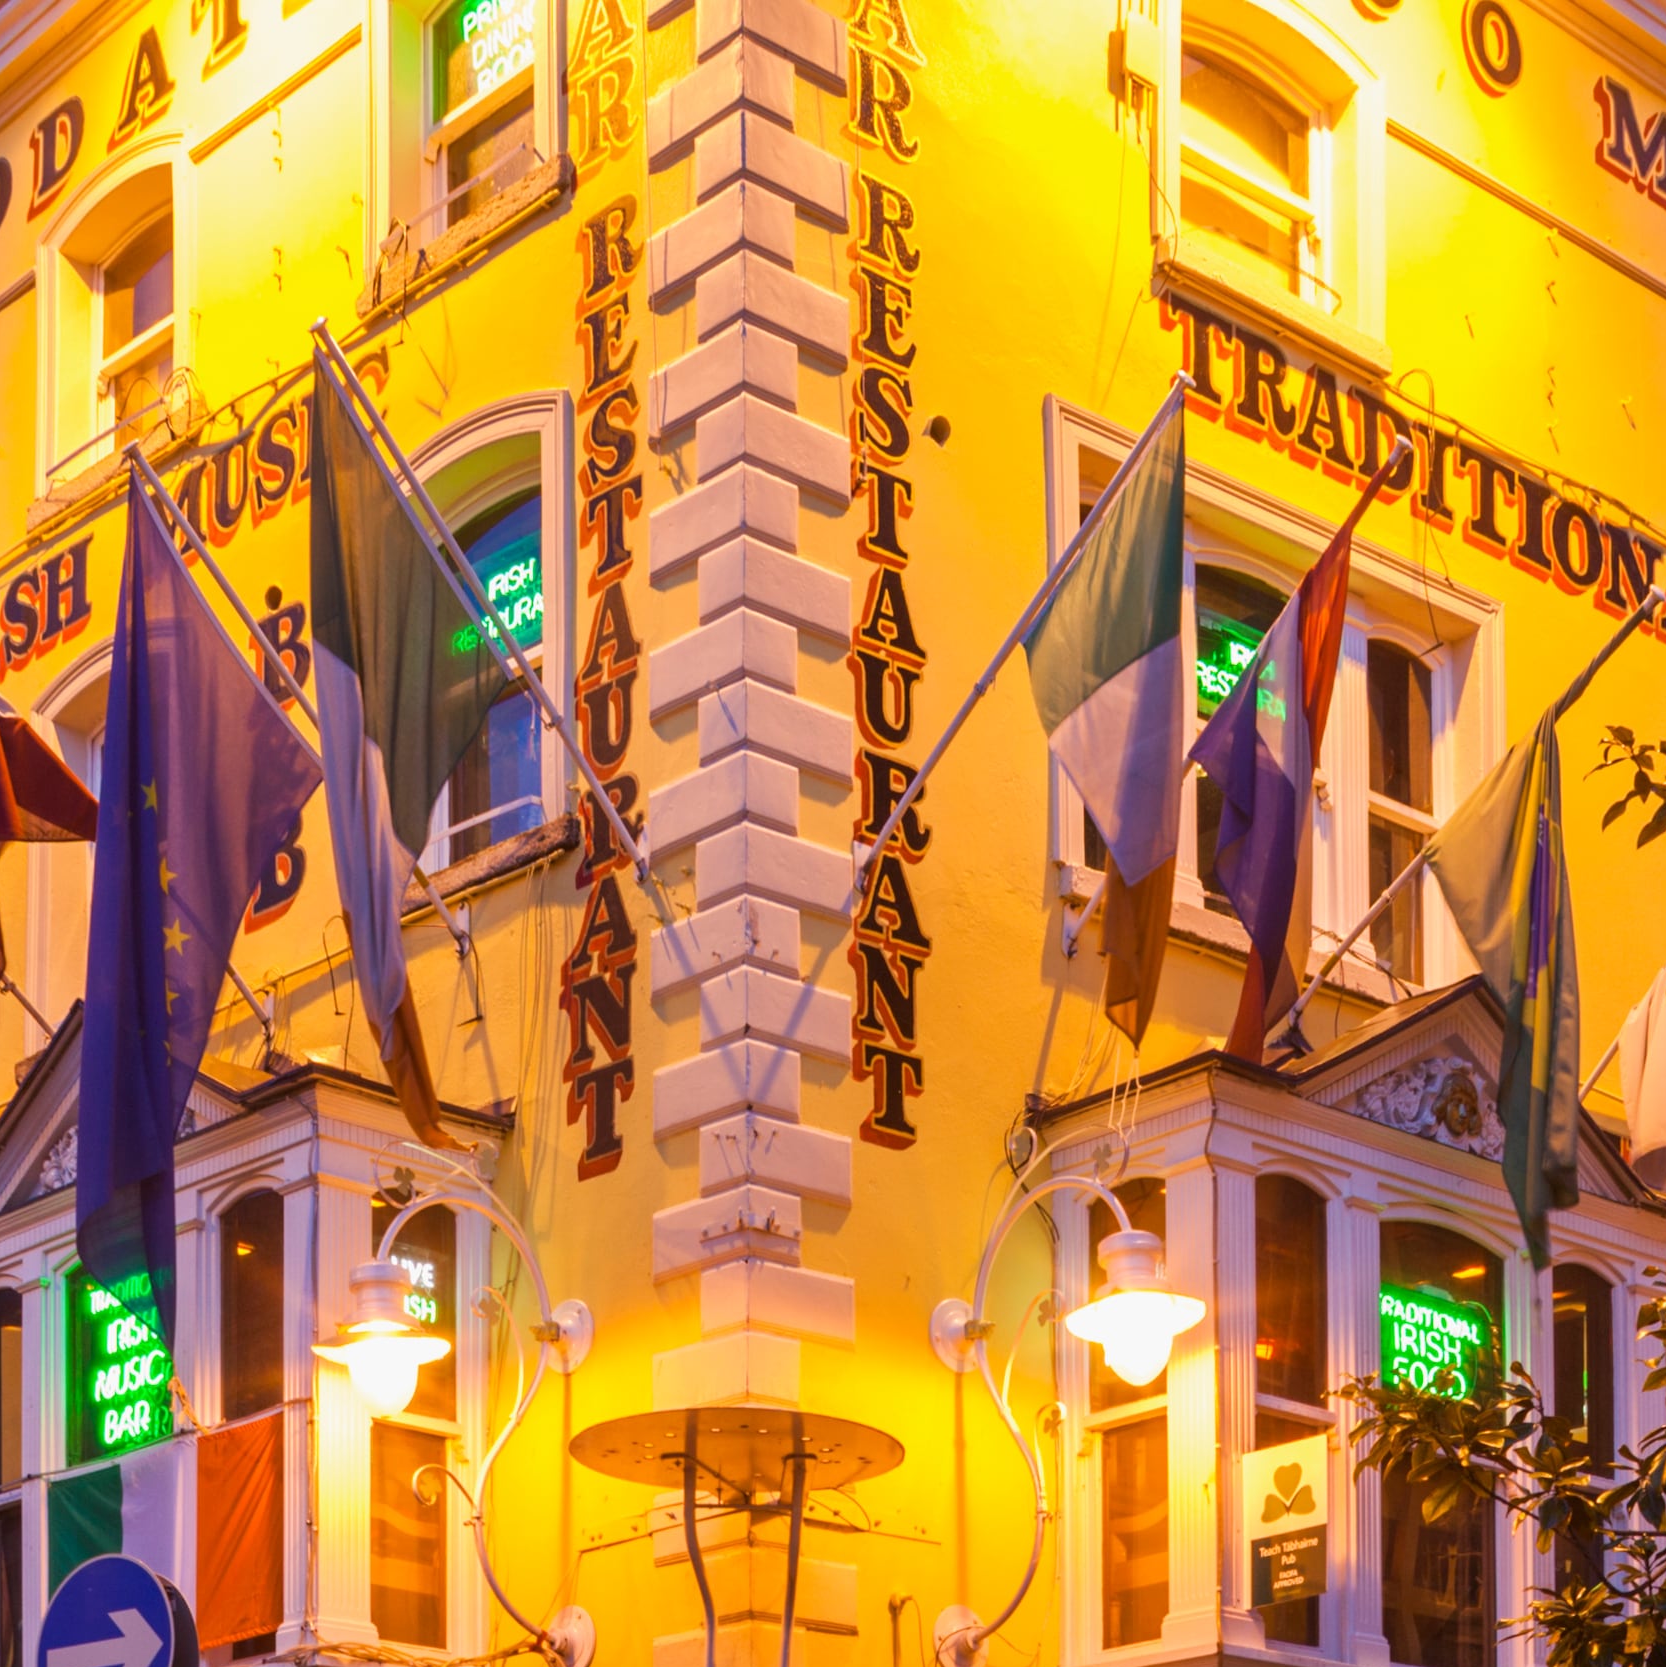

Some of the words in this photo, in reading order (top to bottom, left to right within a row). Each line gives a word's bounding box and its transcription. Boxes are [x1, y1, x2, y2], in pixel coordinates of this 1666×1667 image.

[847, 168, 932, 1150] RESTAURANT
[561, 194, 645, 1181] RESTAURANT
[402, 1294, 438, 1324] ISH
[1380, 1290, 1481, 1345] TRADITIONAL
[1393, 1321, 1463, 1367] IRISH
[94, 1349, 166, 1402] MUSIC
[102, 1400, 152, 1446] BAR
[1259, 1543, 1282, 1558] Teach
[1281, 1553, 1297, 1566] Pub
